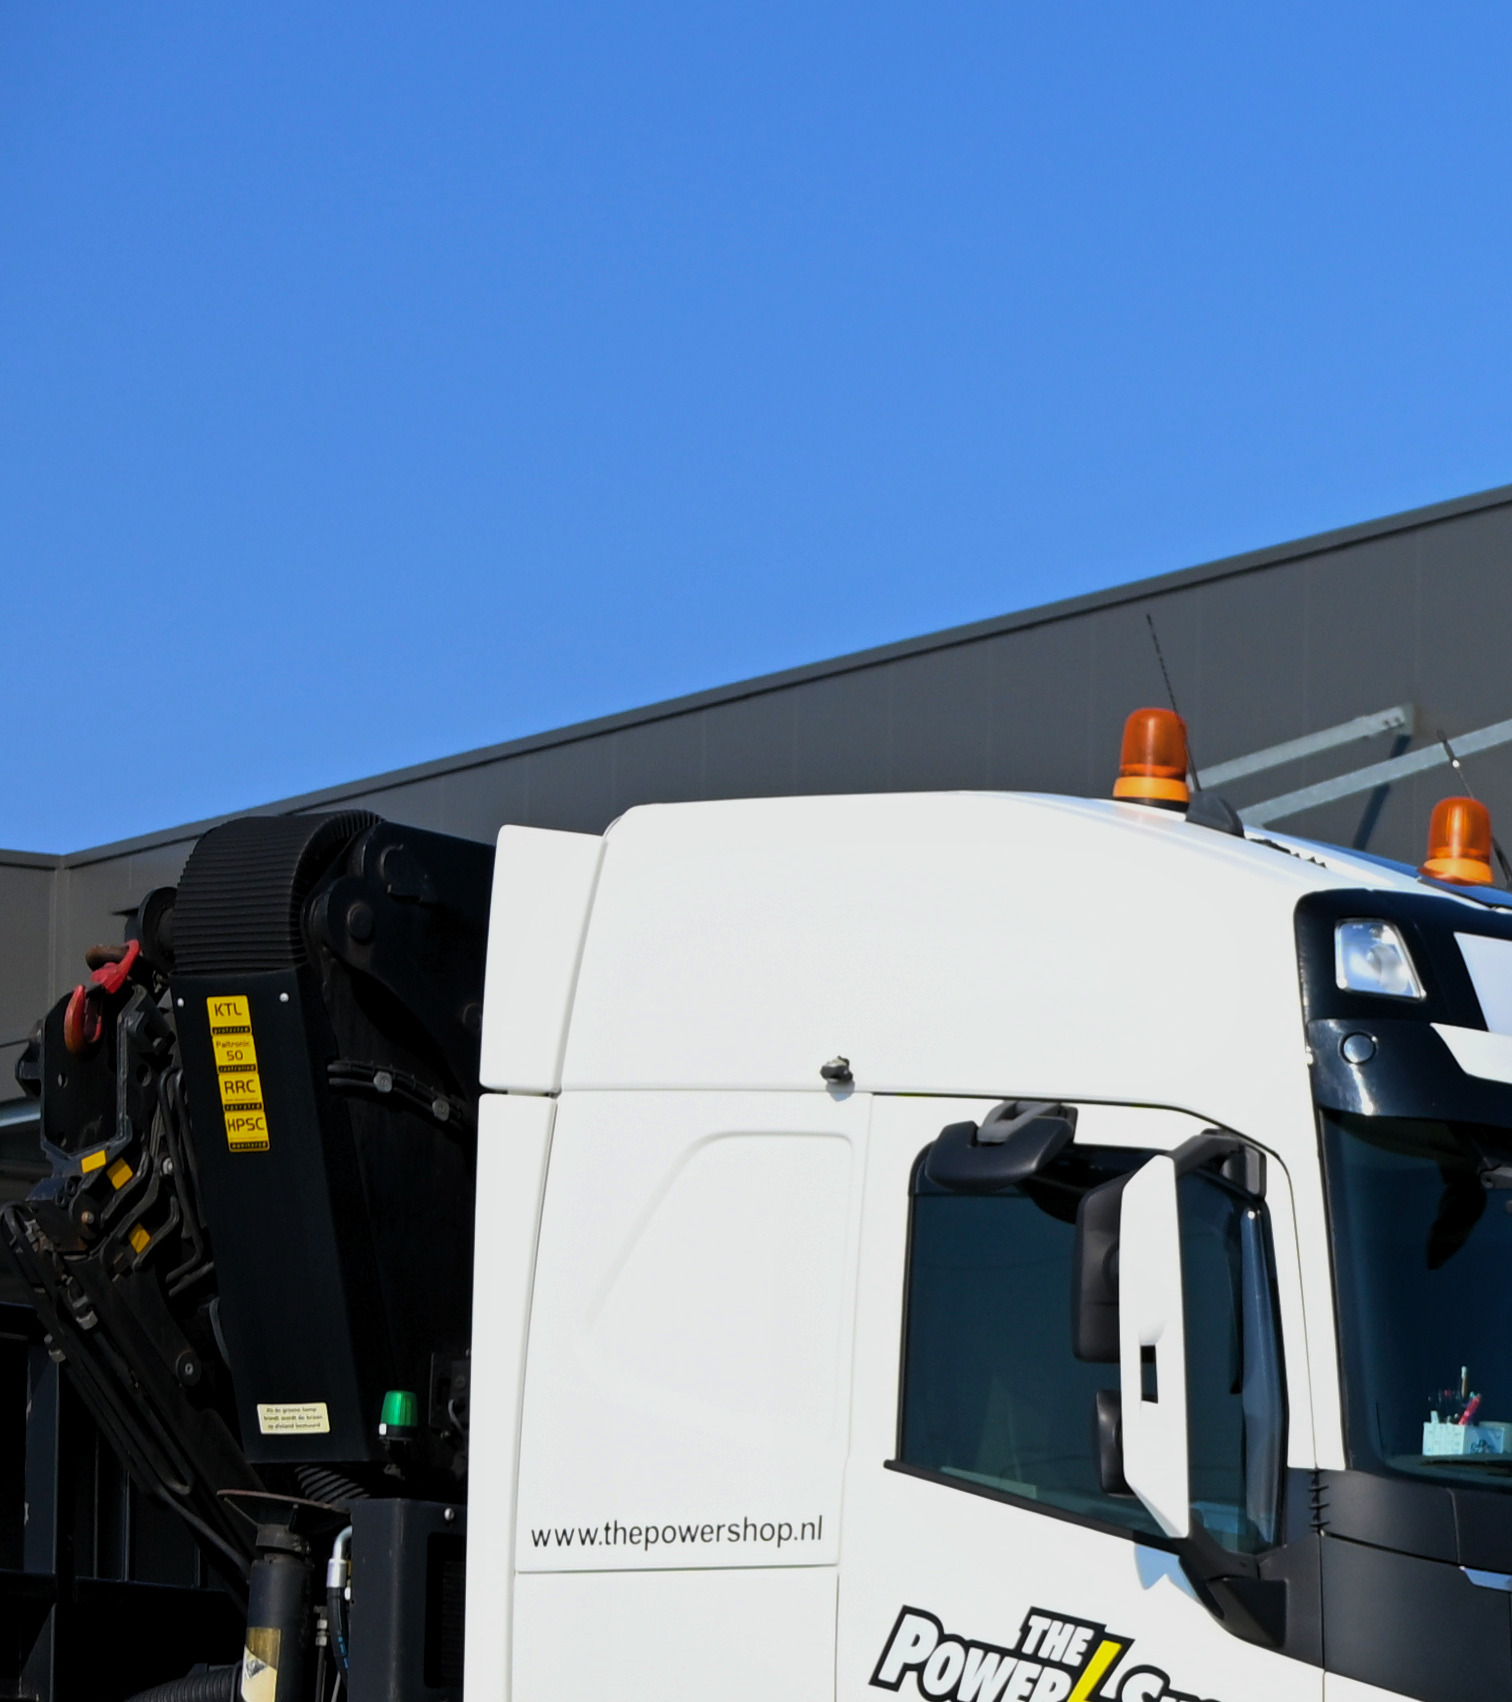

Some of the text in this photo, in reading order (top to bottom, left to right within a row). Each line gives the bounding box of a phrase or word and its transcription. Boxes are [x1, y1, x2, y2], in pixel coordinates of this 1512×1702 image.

[213, 1002, 243, 1017] KTL
[226, 1049, 244, 1061] 50
[223, 1079, 256, 1095] RRC
[227, 1117, 265, 1132] HPSC
[531, 1515, 823, 1551] www.thepowershop.nl
[1019, 1614, 1095, 1668] THE
